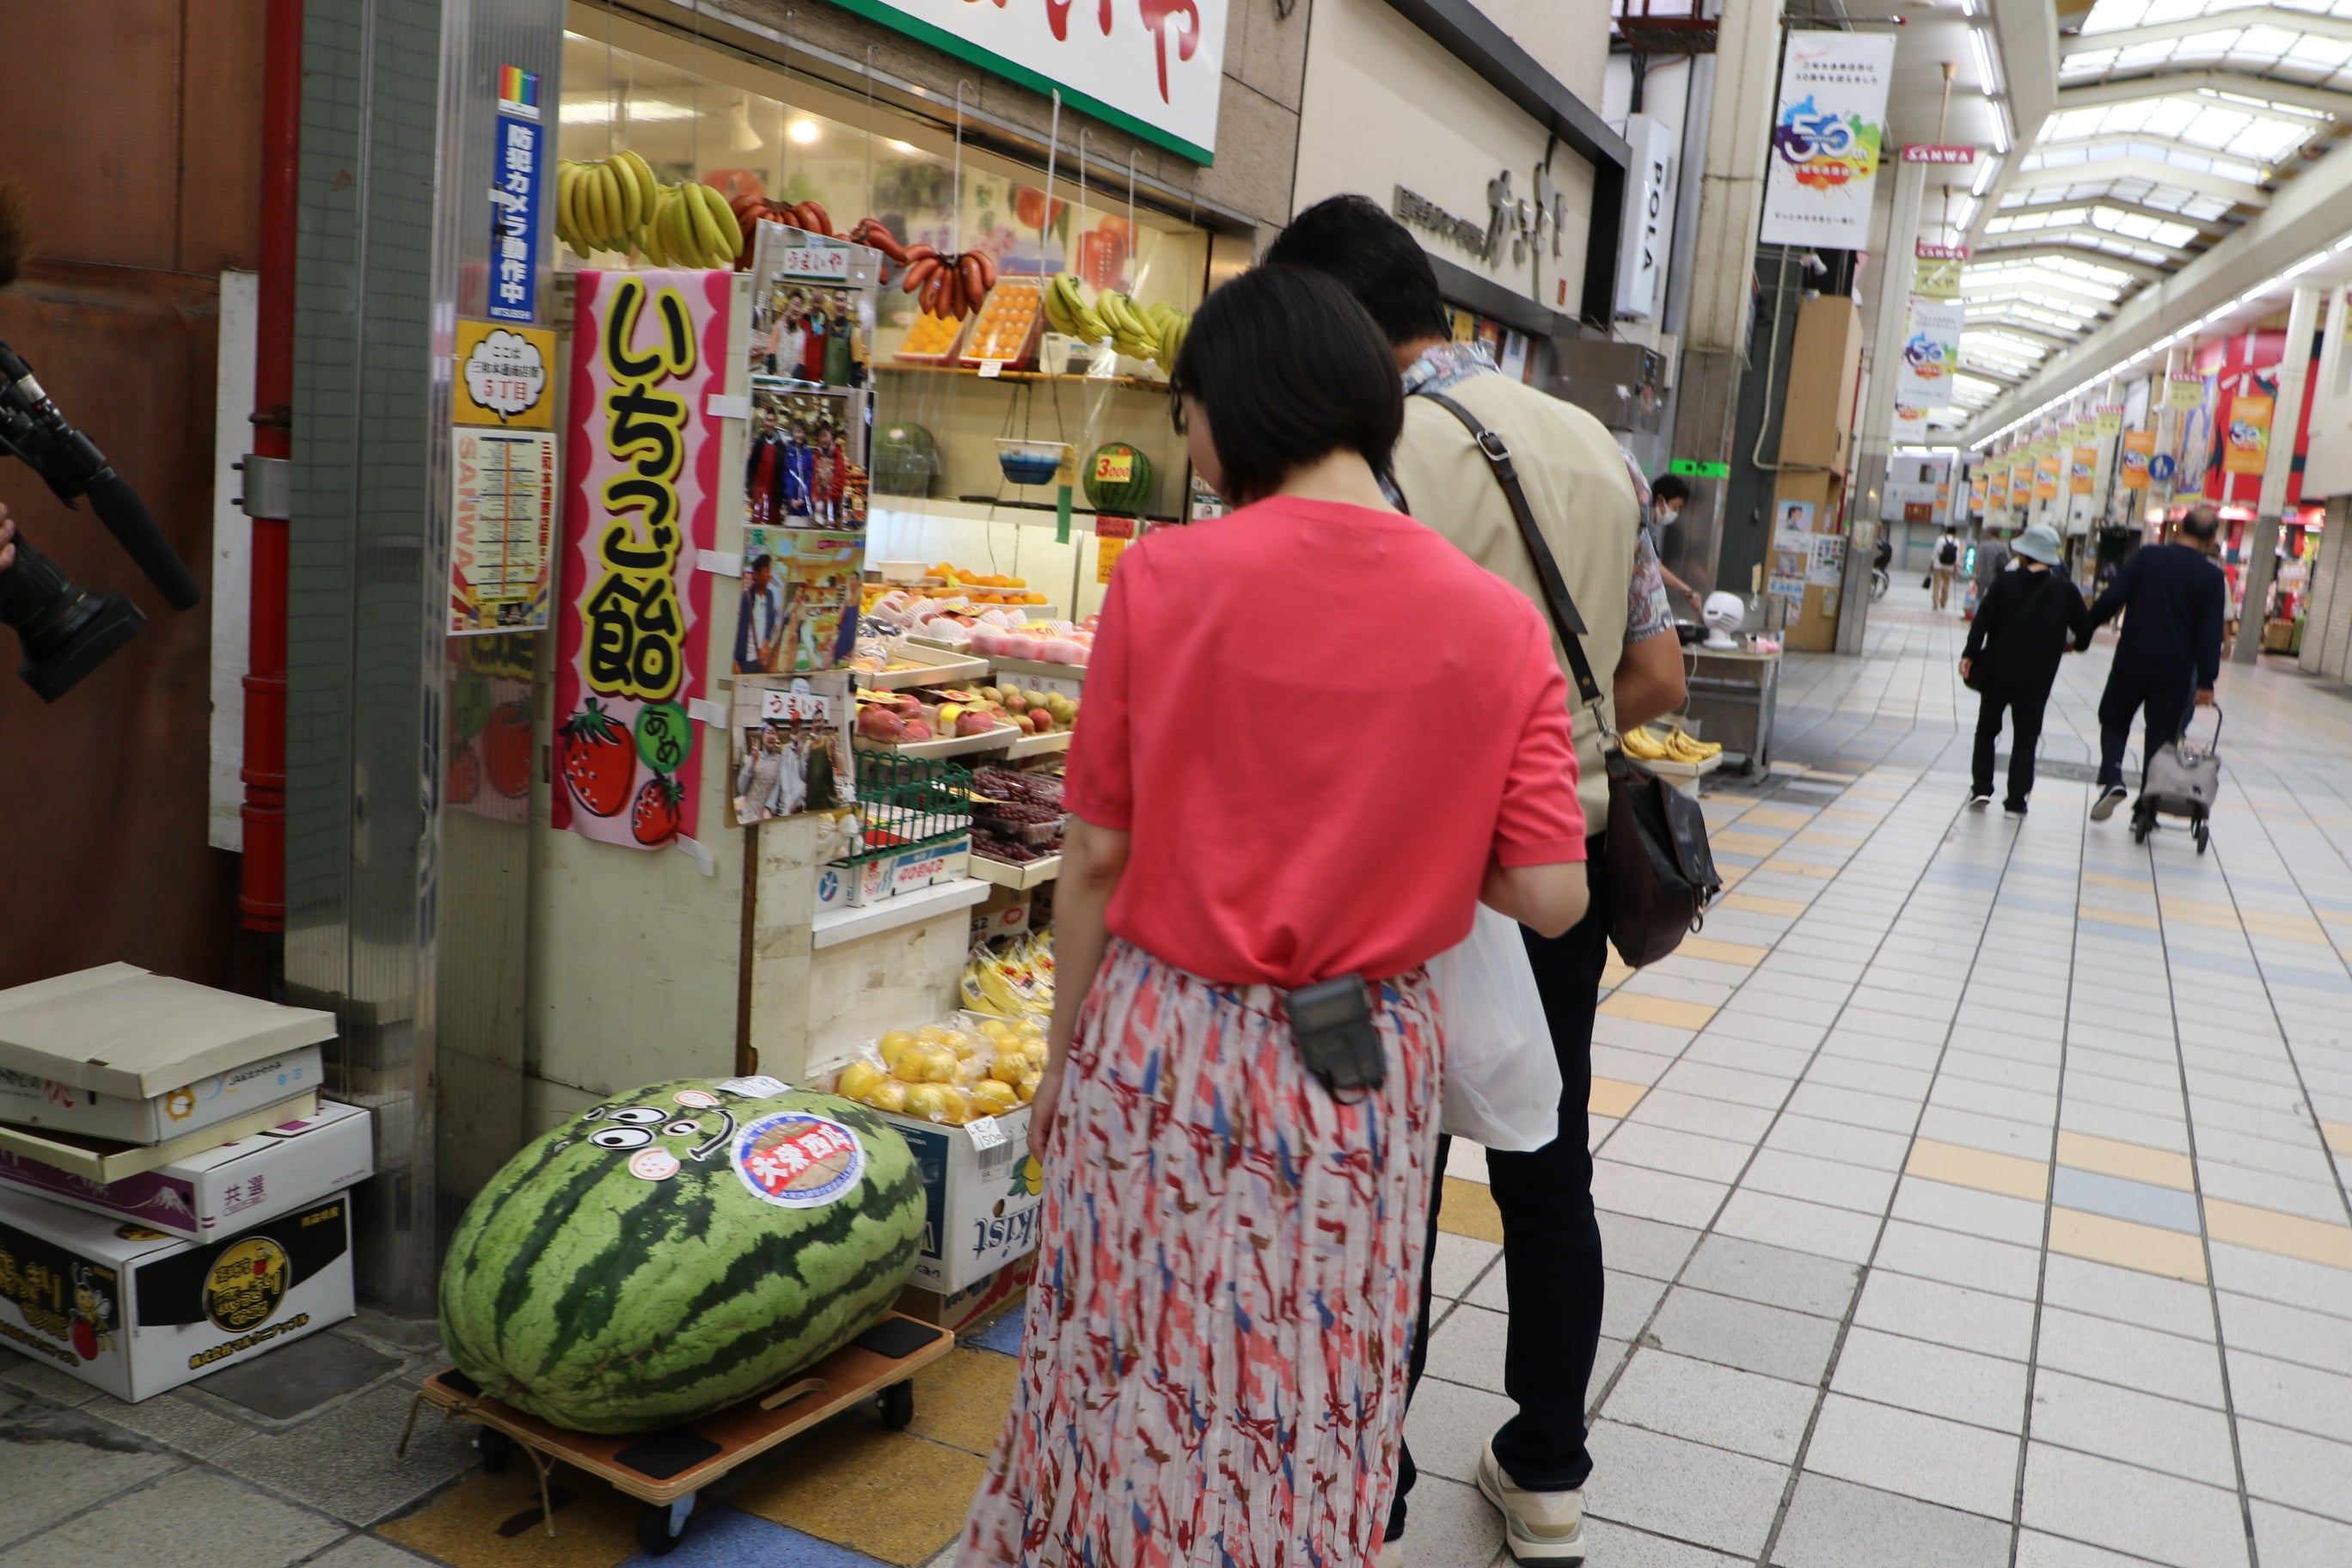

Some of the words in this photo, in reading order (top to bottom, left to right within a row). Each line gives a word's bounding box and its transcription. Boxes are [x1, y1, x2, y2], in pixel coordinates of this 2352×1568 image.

[1908, 147, 1969, 162] SANWA
[499, 123, 535, 304] 防犯カメラ動作中
[1643, 160, 1663, 270] POLA
[470, 361, 541, 378] 三和本通商店街
[493, 346, 521, 359] ここは
[483, 379, 528, 401] 5丁目
[586, 279, 693, 695] いちご飴
[1097, 458, 1131, 478] 3000
[456, 437, 477, 570] SANWA
[538, 440, 552, 569] 三和本通商店街
[967, 1119, 992, 1135] レモン
[750, 1124, 851, 1188] 大栄西瓜
[972, 1206, 1038, 1261] kist
